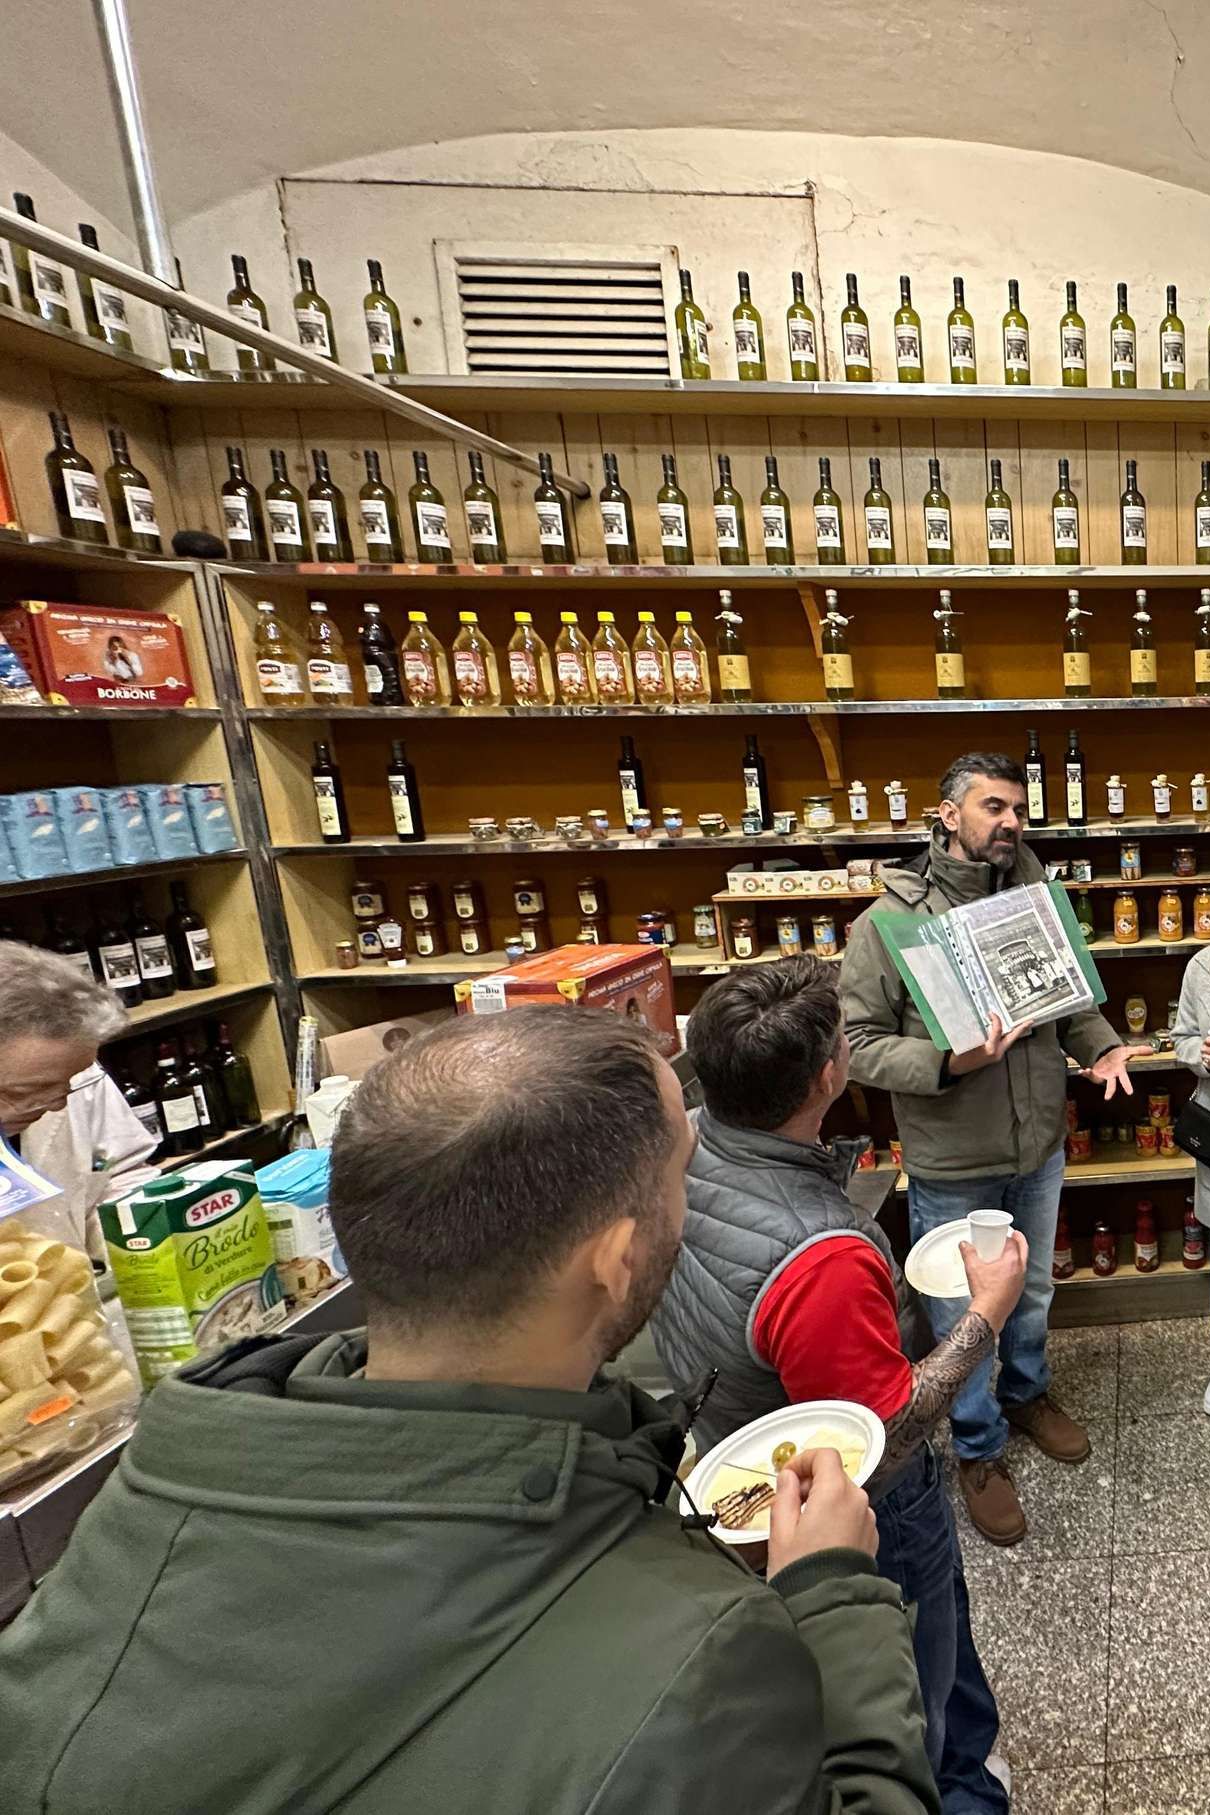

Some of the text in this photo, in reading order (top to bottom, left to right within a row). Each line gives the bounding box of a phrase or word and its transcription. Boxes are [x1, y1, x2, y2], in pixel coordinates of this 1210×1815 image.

[97, 687, 157, 700] BORBONE
[191, 1194, 235, 1222] STAR
[128, 1239, 148, 1247] STAR
[184, 1215, 260, 1271] Brodo
